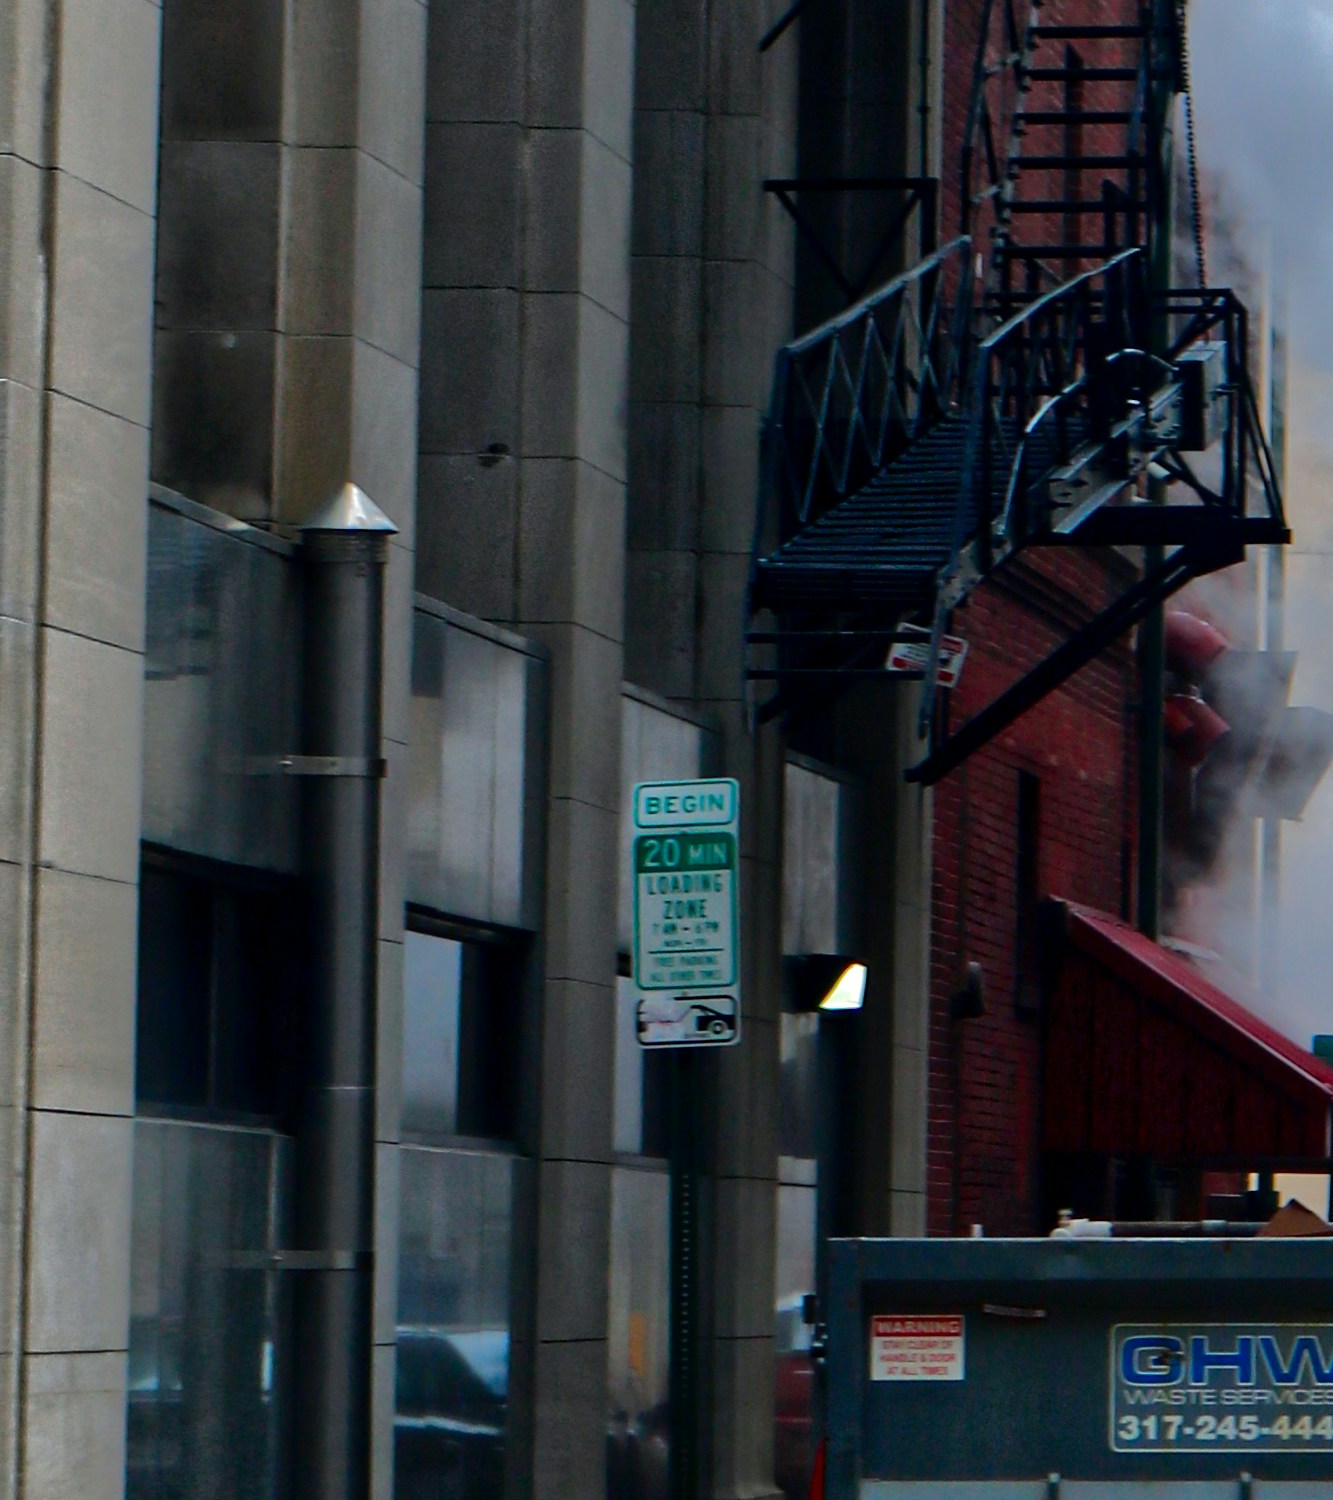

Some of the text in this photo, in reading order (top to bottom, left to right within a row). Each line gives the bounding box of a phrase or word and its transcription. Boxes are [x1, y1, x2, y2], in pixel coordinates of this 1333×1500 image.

[645, 794, 724, 815] BEGIN
[643, 838, 727, 868] 20 MIN
[646, 873, 723, 896] LOADING
[663, 899, 708, 920] ZONE
[879, 1320, 961, 1334] WARNING
[1123, 1389, 1217, 1406] WASTE
